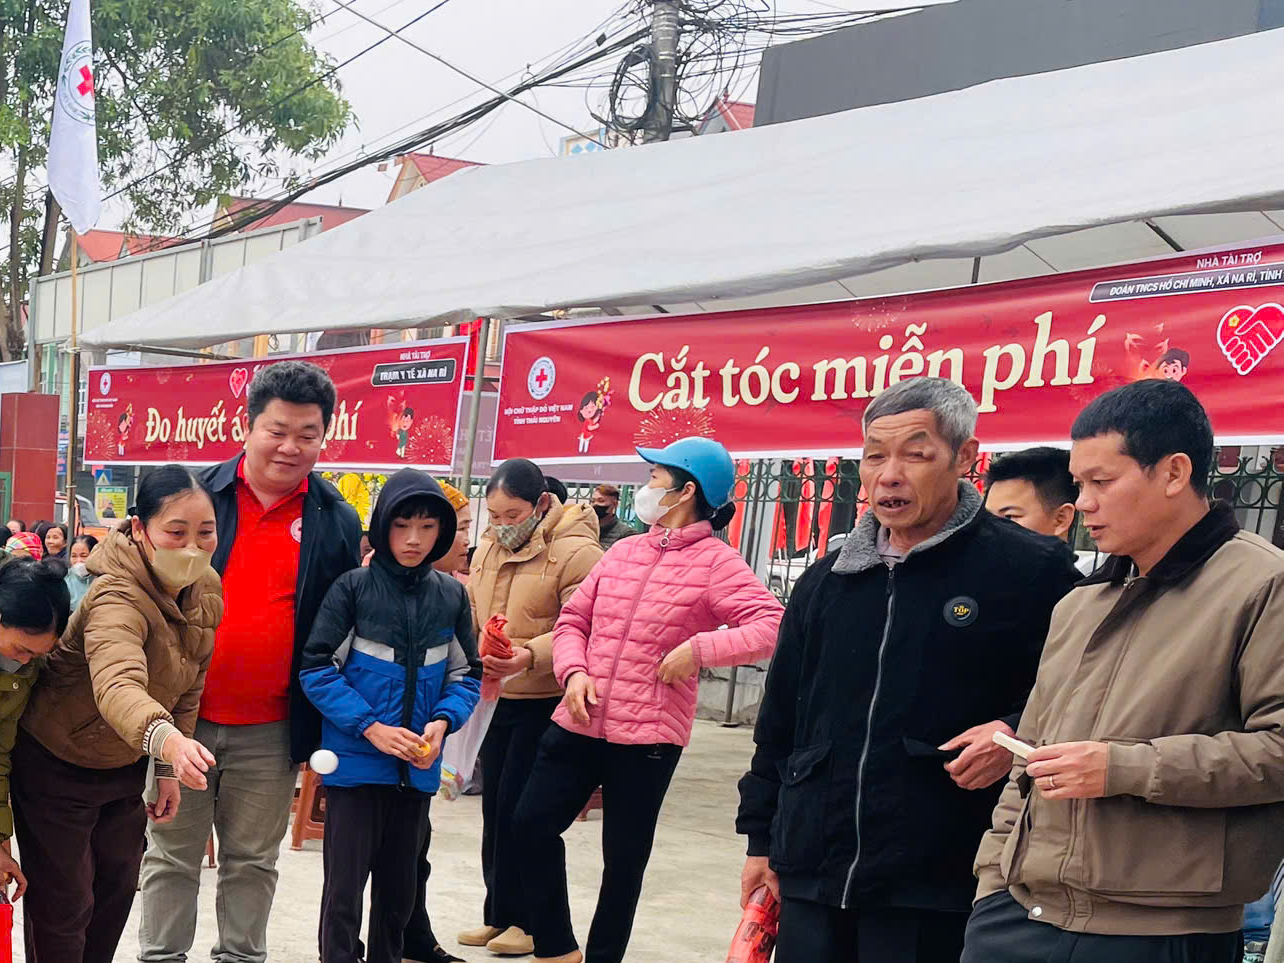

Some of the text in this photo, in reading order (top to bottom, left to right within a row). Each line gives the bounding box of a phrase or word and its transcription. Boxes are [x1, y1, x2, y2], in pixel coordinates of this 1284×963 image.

[1196, 251, 1262, 269] NHÀ TÀI TRỢ
[1135, 283, 1158, 295] TNCS
[1173, 276, 1190, 290] CHÍ
[1189, 277, 1215, 289] MINH,
[1216, 273, 1230, 285] XÃ
[1231, 273, 1245, 284] NA
[628, 311, 1107, 413] Cắt tóc miễn phí
[380, 370, 399, 382] TRẠM
[400, 370, 406, 380] Y
[406, 367, 416, 379] TẾ
[417, 367, 426, 379] XÃ
[145, 407, 171, 443] Đo
[174, 400, 227, 449] huyết
